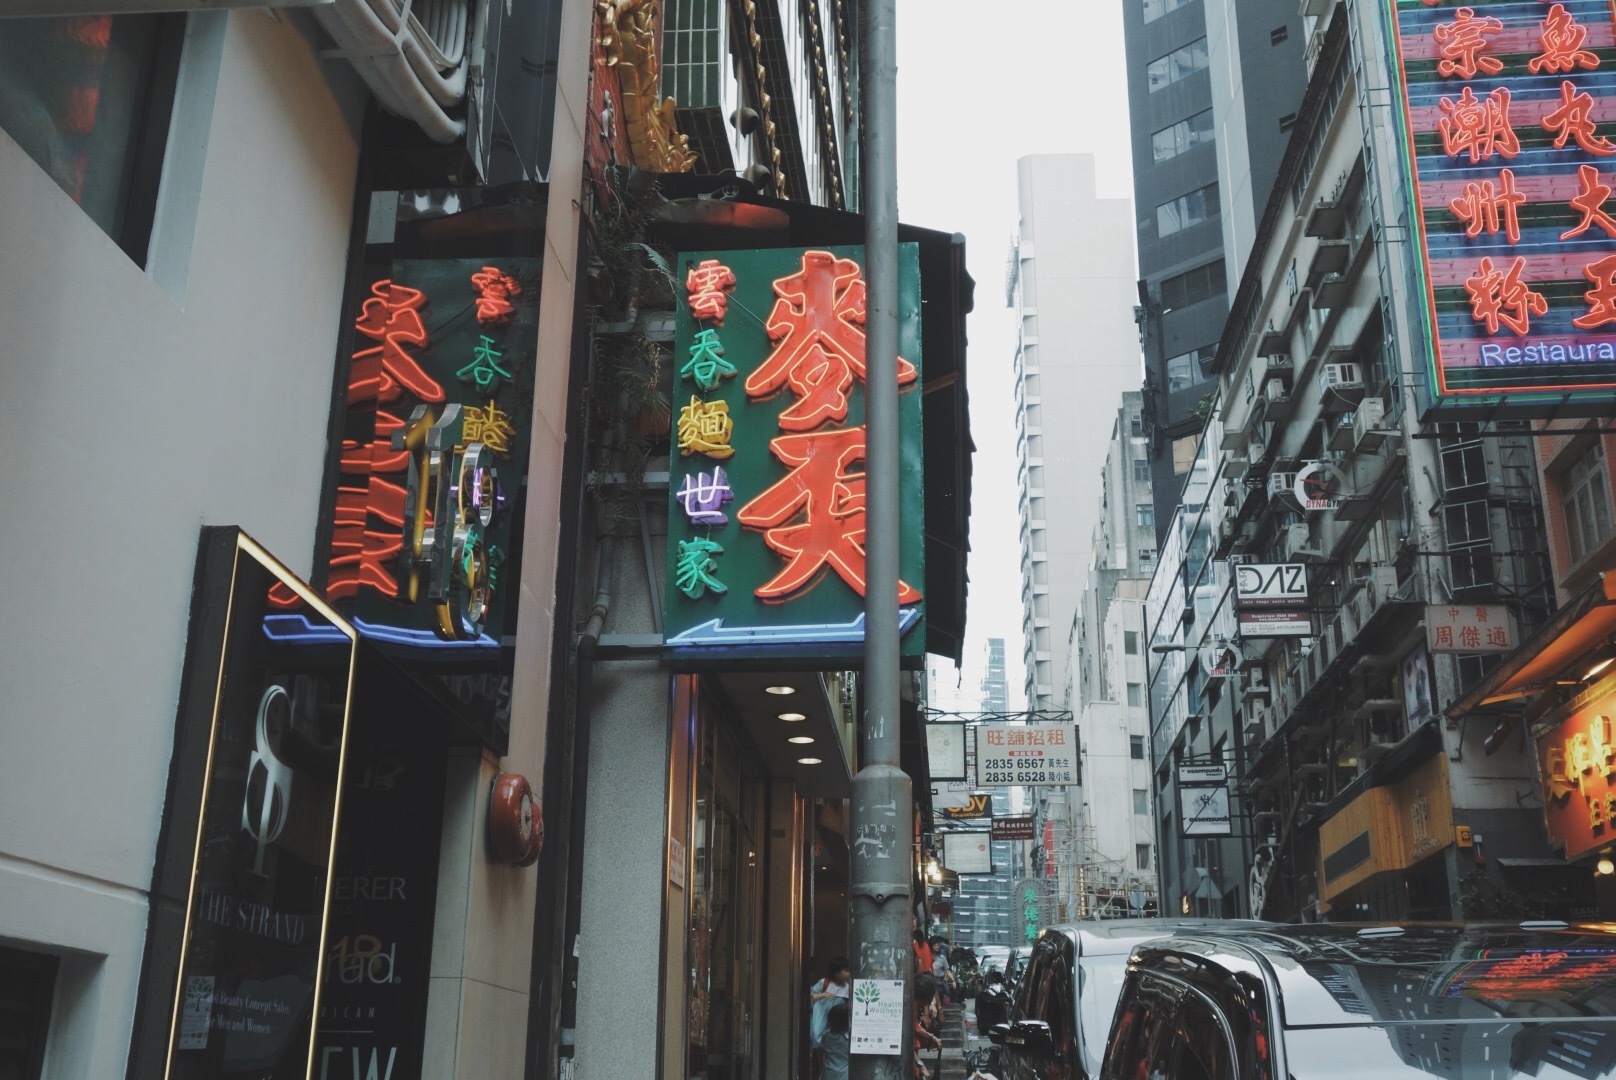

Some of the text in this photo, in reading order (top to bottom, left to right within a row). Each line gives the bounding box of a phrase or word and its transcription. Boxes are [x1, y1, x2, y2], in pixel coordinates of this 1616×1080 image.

[1481, 341, 1615, 366] Restaura
[1238, 566, 1304, 594] DAZ
[1448, 607, 1489, 623] 中醫
[1435, 625, 1509, 648] 周傑通
[985, 758, 1013, 769] 2835
[1017, 758, 1045, 769] 6567
[985, 772, 1014, 783] 2835
[1017, 771, 1046, 782] 6528
